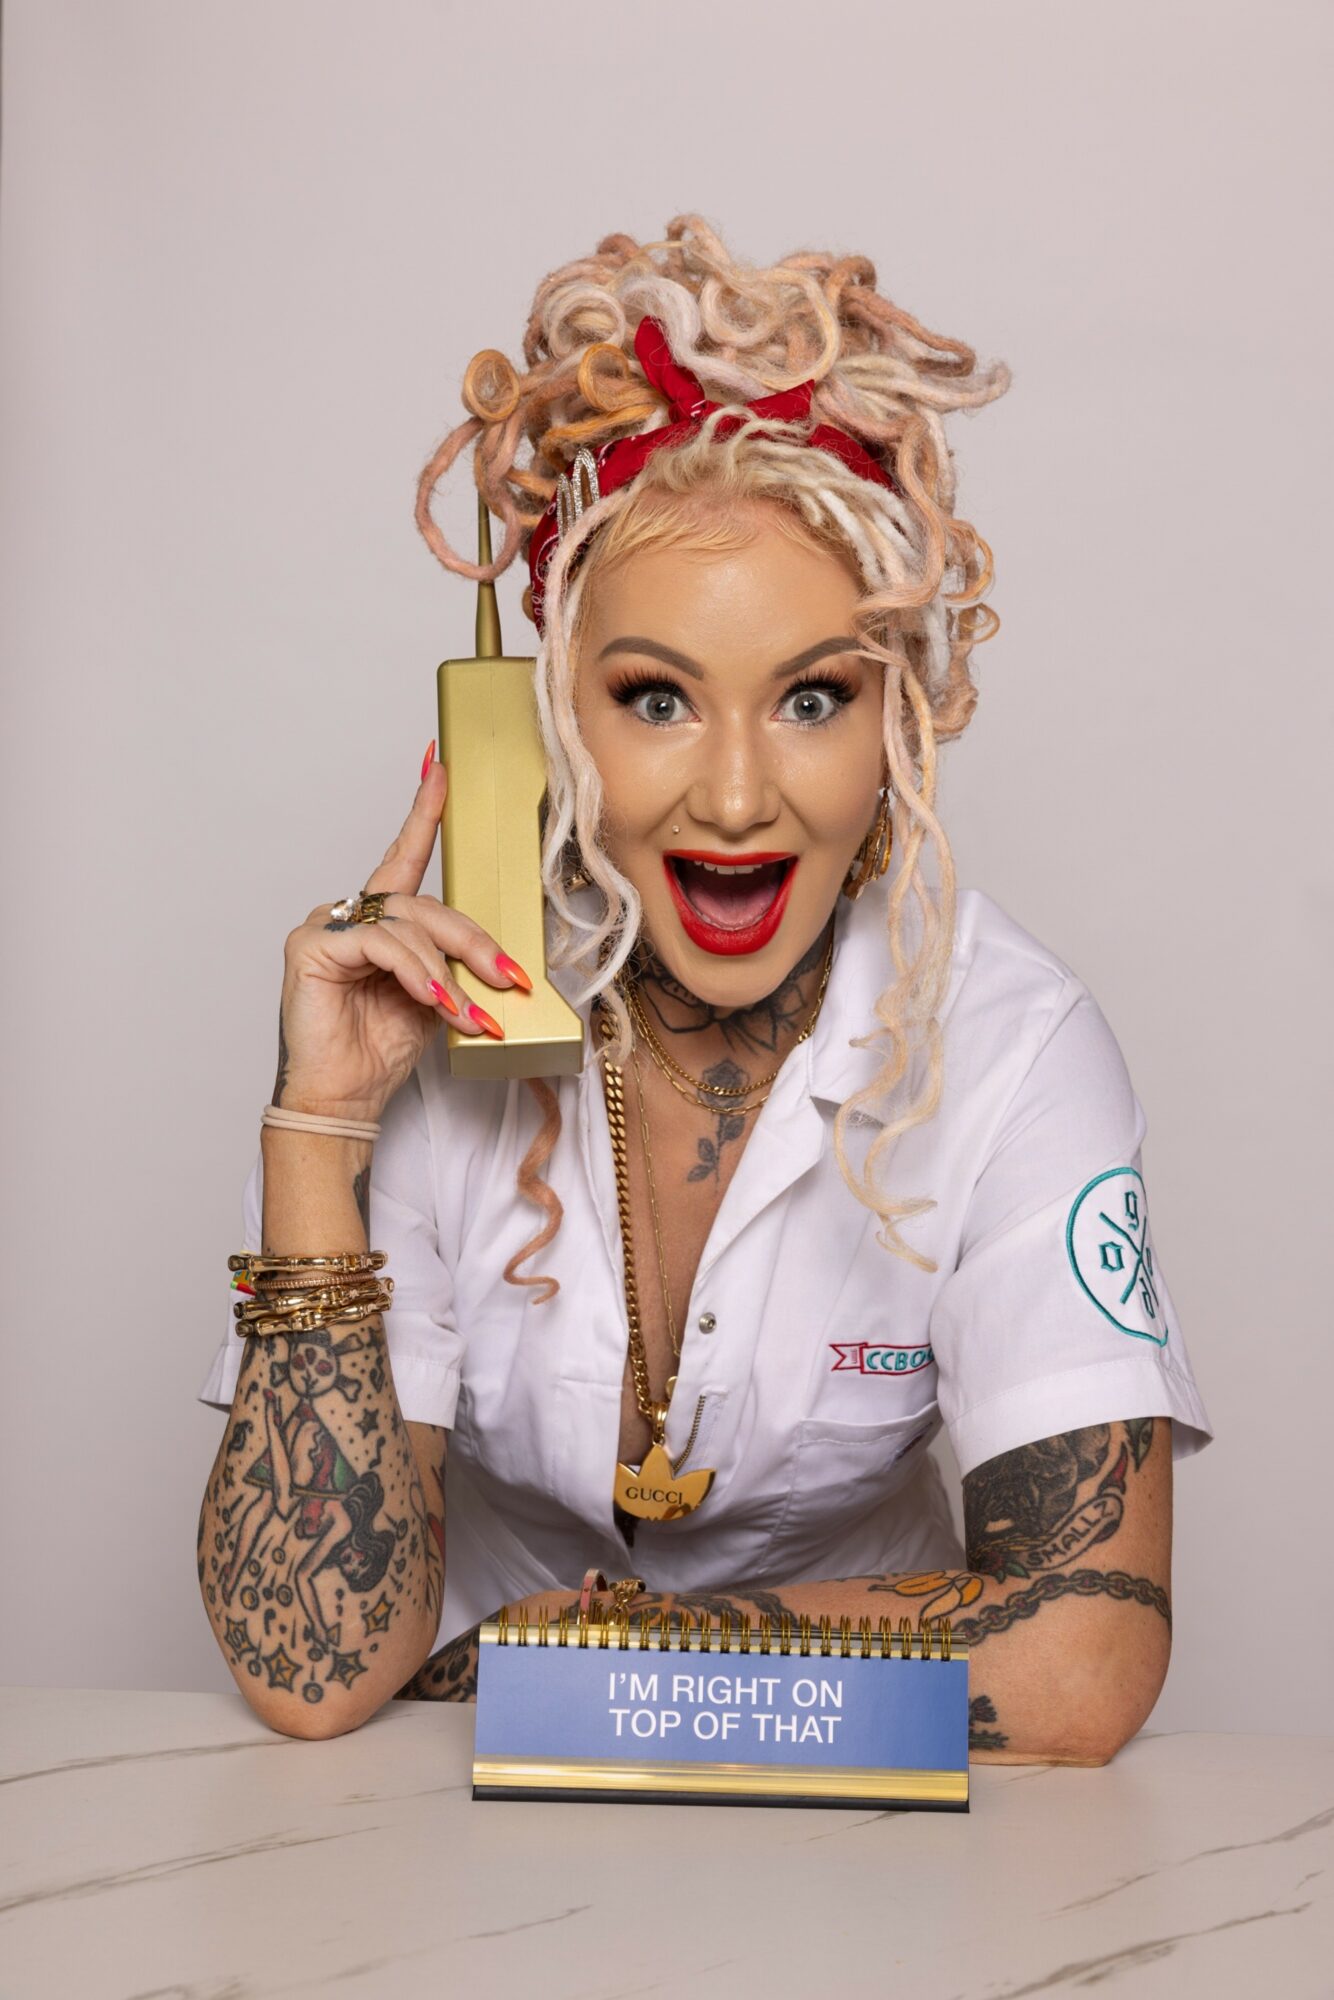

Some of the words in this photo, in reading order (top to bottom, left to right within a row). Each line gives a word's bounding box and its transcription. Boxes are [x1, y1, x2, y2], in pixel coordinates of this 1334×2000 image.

[625, 1486, 683, 1505] GUCCI
[1026, 1500, 1114, 1566] SMALLZ
[608, 1672, 659, 1702] I'M
[672, 1674, 781, 1706] RIGHT
[792, 1678, 843, 1708] ON
[608, 1708, 682, 1738] TOP
[693, 1711, 741, 1740] OF
[751, 1713, 842, 1744] THAT
